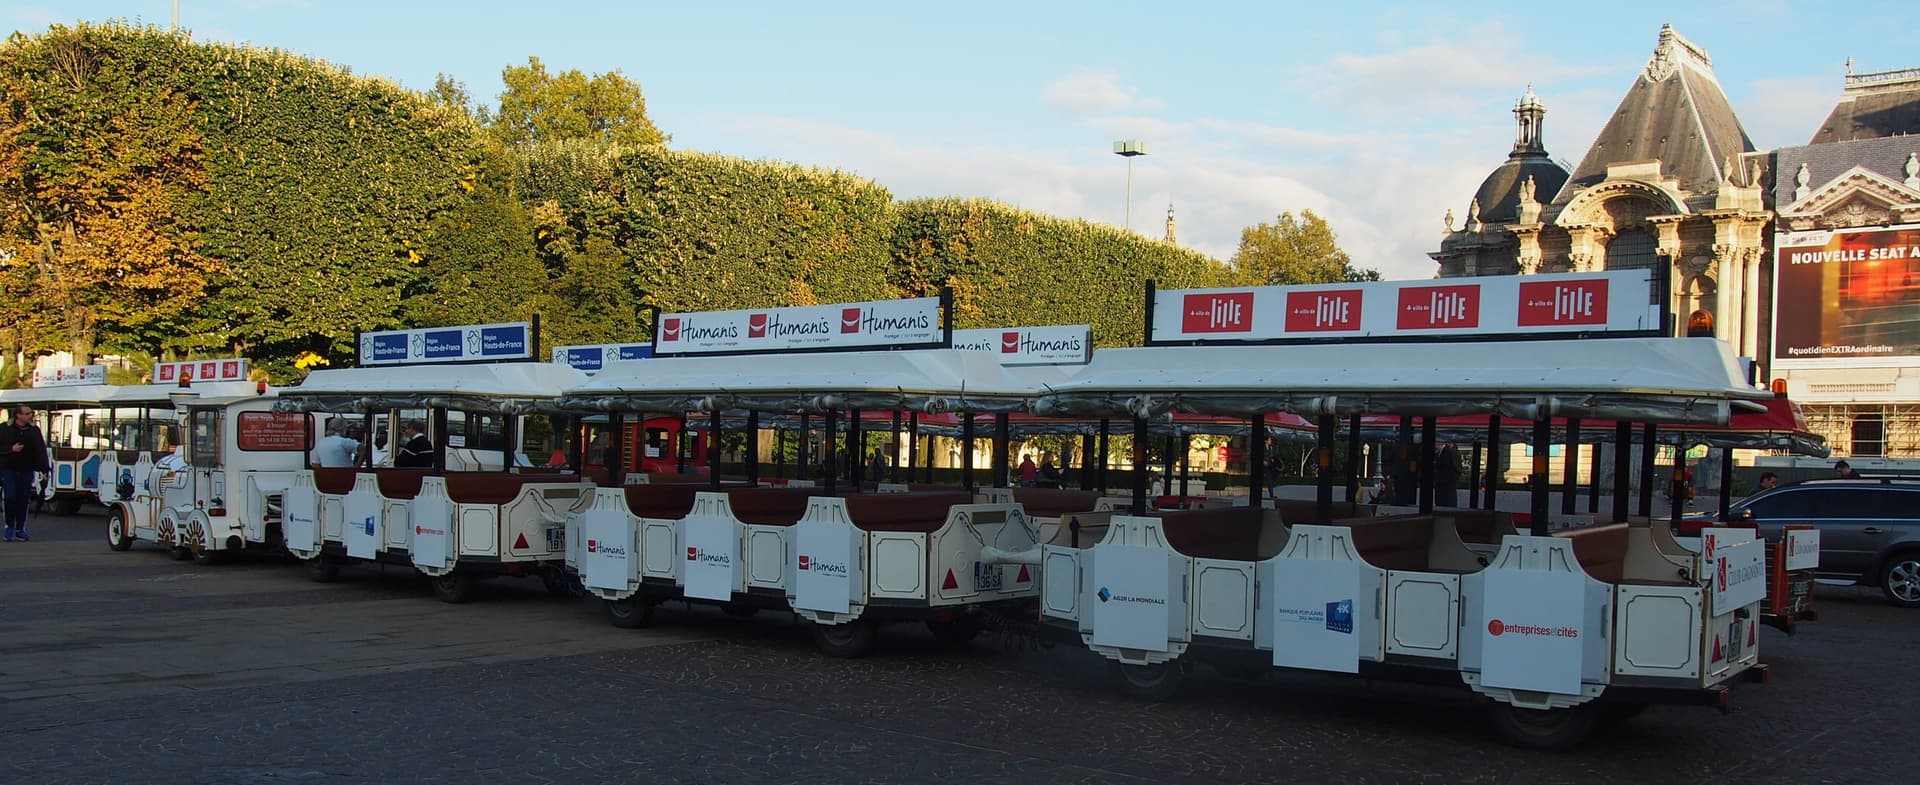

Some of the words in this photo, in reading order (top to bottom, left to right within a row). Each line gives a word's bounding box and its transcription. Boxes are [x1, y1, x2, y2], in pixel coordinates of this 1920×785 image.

[1791, 249, 1866, 264] NOUVELLE
[1868, 246, 1907, 260] SEAT
[768, 313, 829, 339] Humanis
[862, 307, 929, 334] Humanis
[681, 318, 738, 342] Humanis
[954, 339, 992, 351] manis
[1020, 332, 1080, 354] Humanis
[1788, 344, 1894, 356] #quotidienEXTRAordinaire
[597, 540, 625, 555] Humanis
[698, 548, 730, 563] Humanis
[810, 556, 846, 573] Humanis
